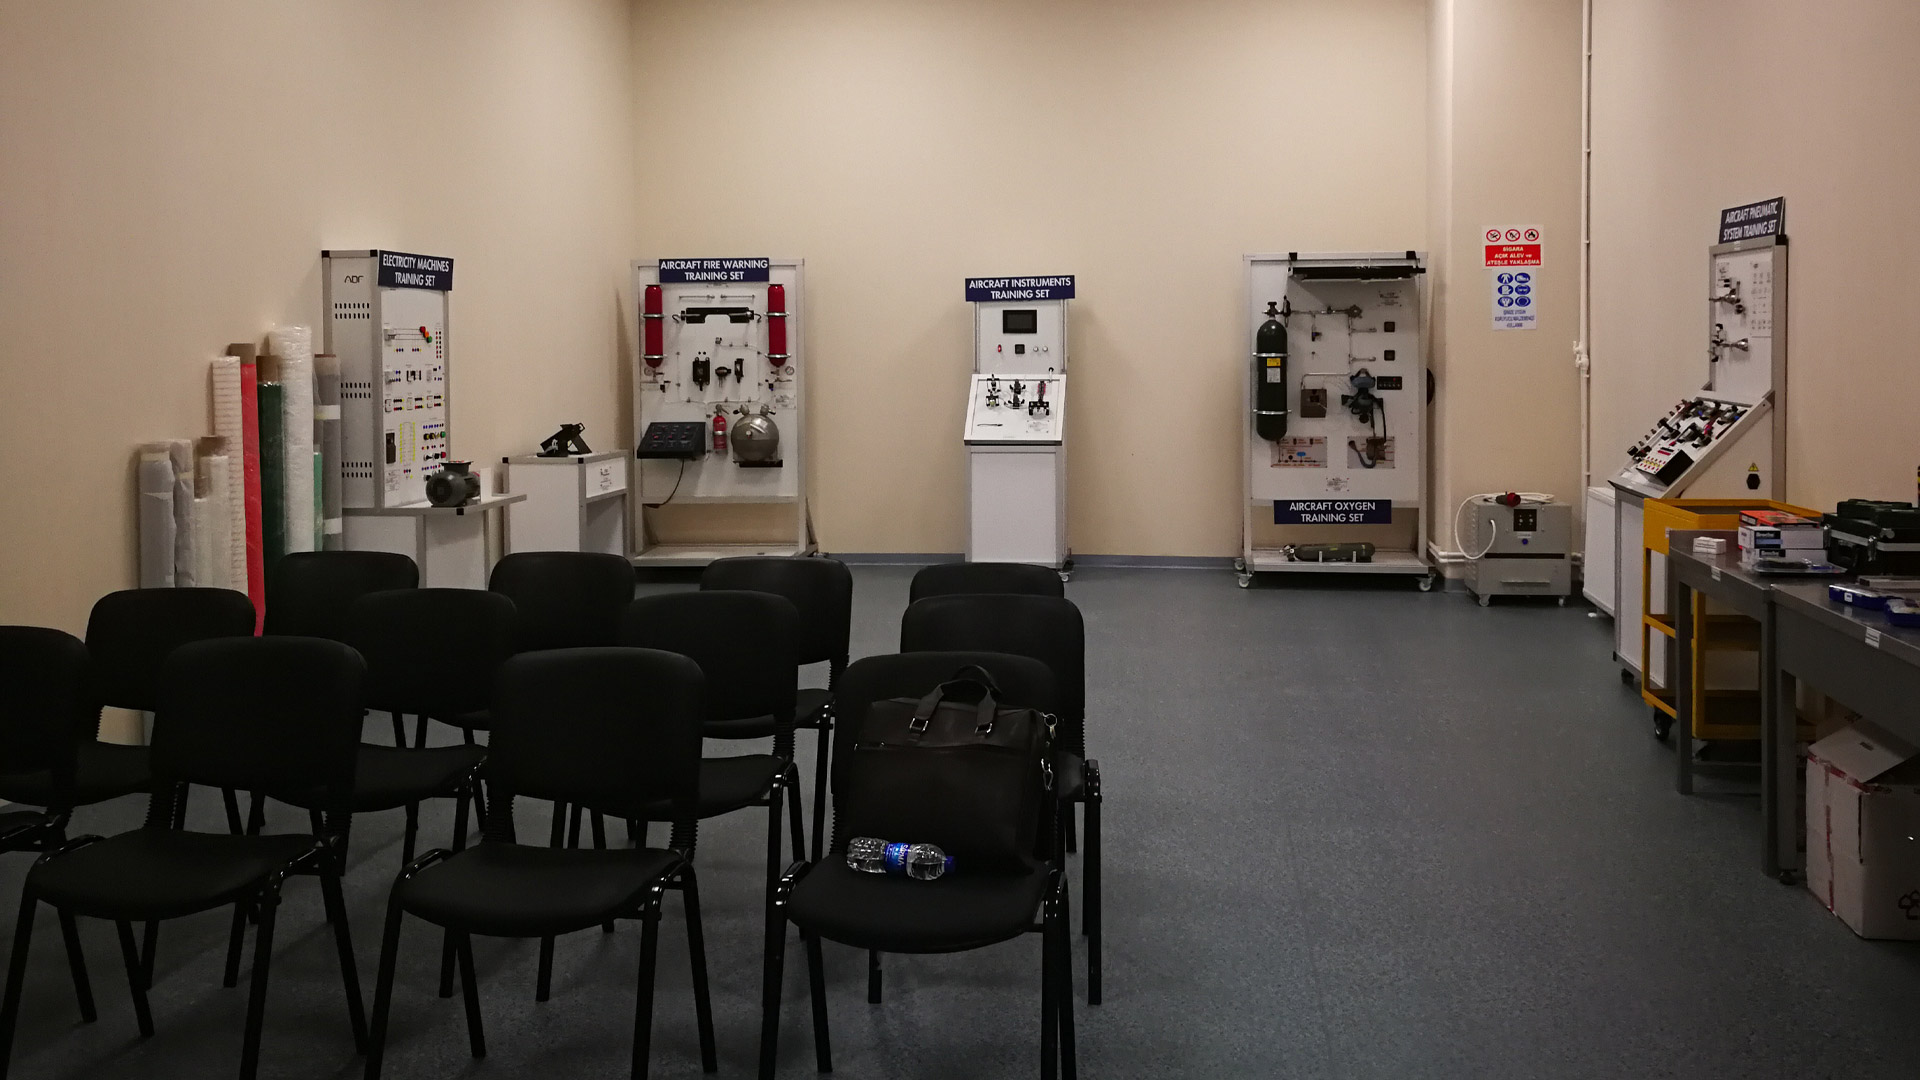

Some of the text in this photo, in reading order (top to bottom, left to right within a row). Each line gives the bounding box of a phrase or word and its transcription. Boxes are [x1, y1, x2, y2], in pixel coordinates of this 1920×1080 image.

[1725, 201, 1778, 224] AIRCRAFT PNEUMATIC
[1723, 220, 1777, 241] SYSTEM TRAINING SET
[382, 253, 450, 272] ELECTRICITY MACHINES
[660, 259, 768, 270] AIRCRAFT FIRE WARNING
[395, 271, 436, 287] TRAINING SET
[684, 271, 745, 281] TRAINING SET
[968, 277, 1071, 289] AIRCRAFT INSTRUMENTS
[990, 289, 1050, 300] TRAINING SET
[1289, 502, 1376, 511] AIRCRAFT OXYGEN
[1300, 513, 1364, 523] TRAINING SET
